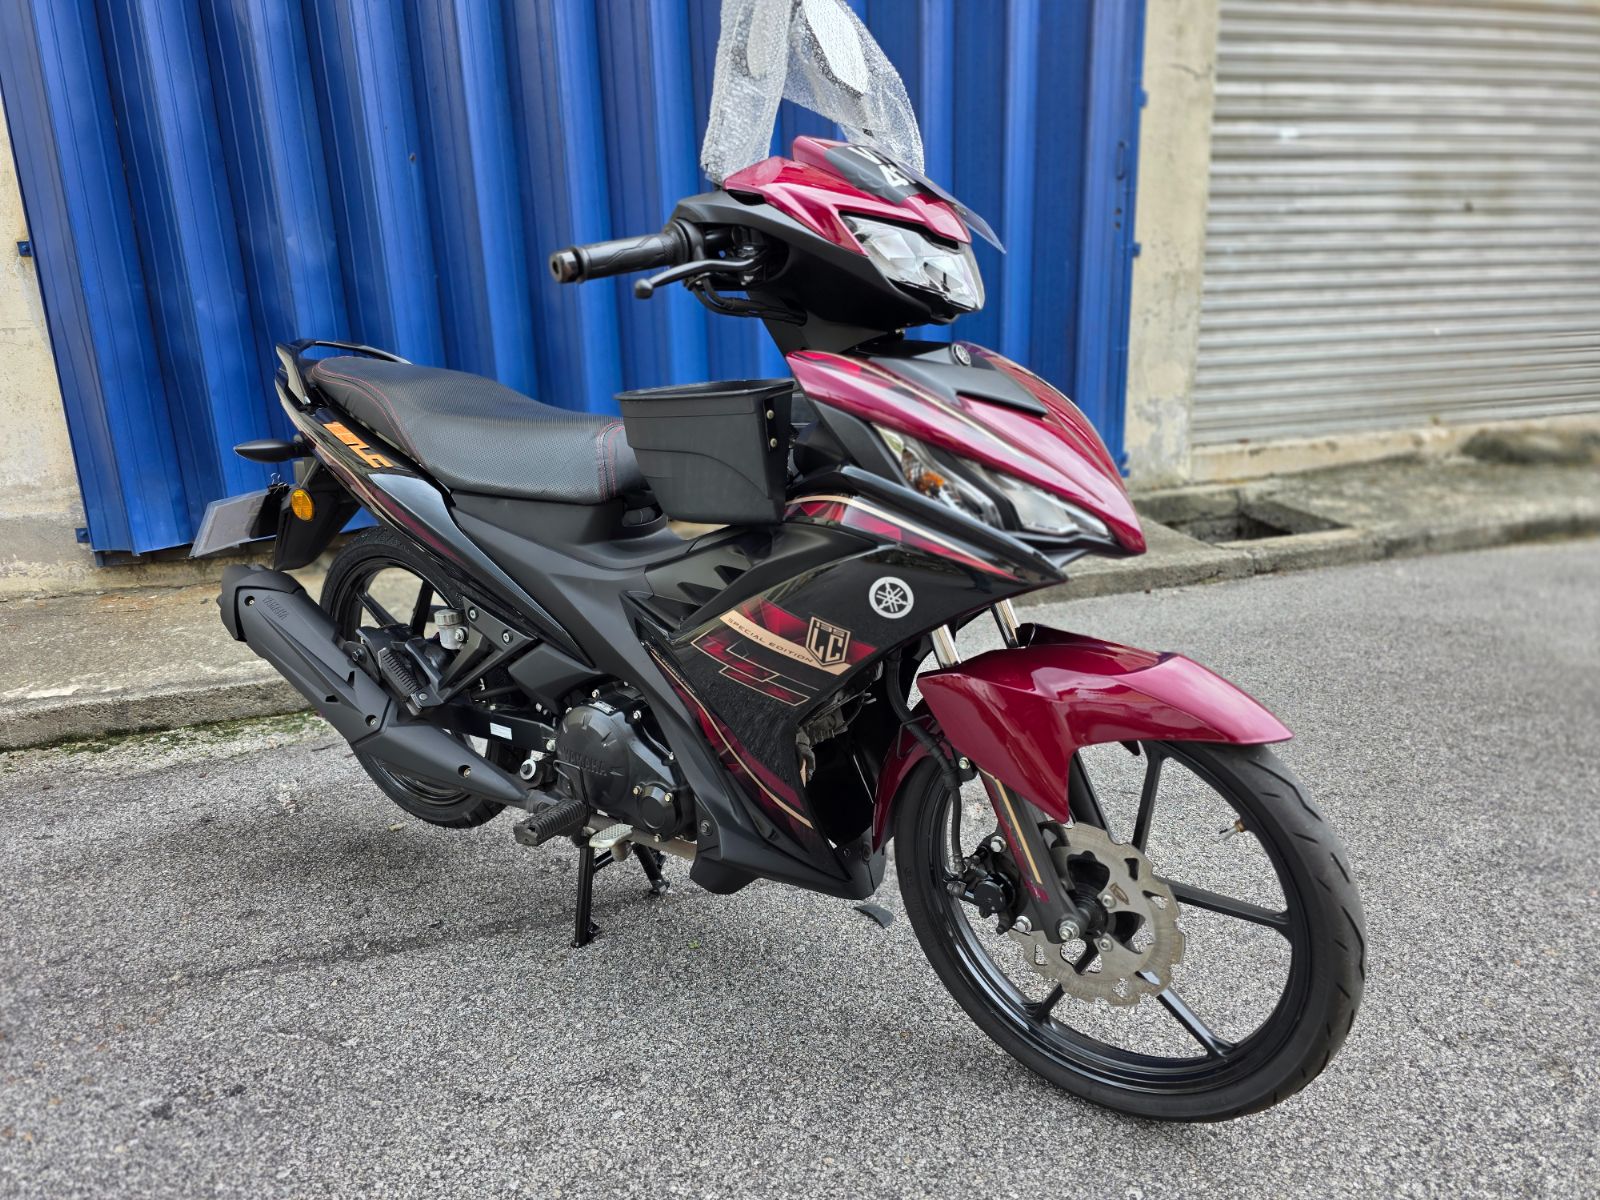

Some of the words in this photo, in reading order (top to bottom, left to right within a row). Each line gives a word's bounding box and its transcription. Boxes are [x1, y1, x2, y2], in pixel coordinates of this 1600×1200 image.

[728, 617, 767, 643] SPECIAL
[768, 642, 813, 663] EDITION
[810, 627, 844, 662] LC
